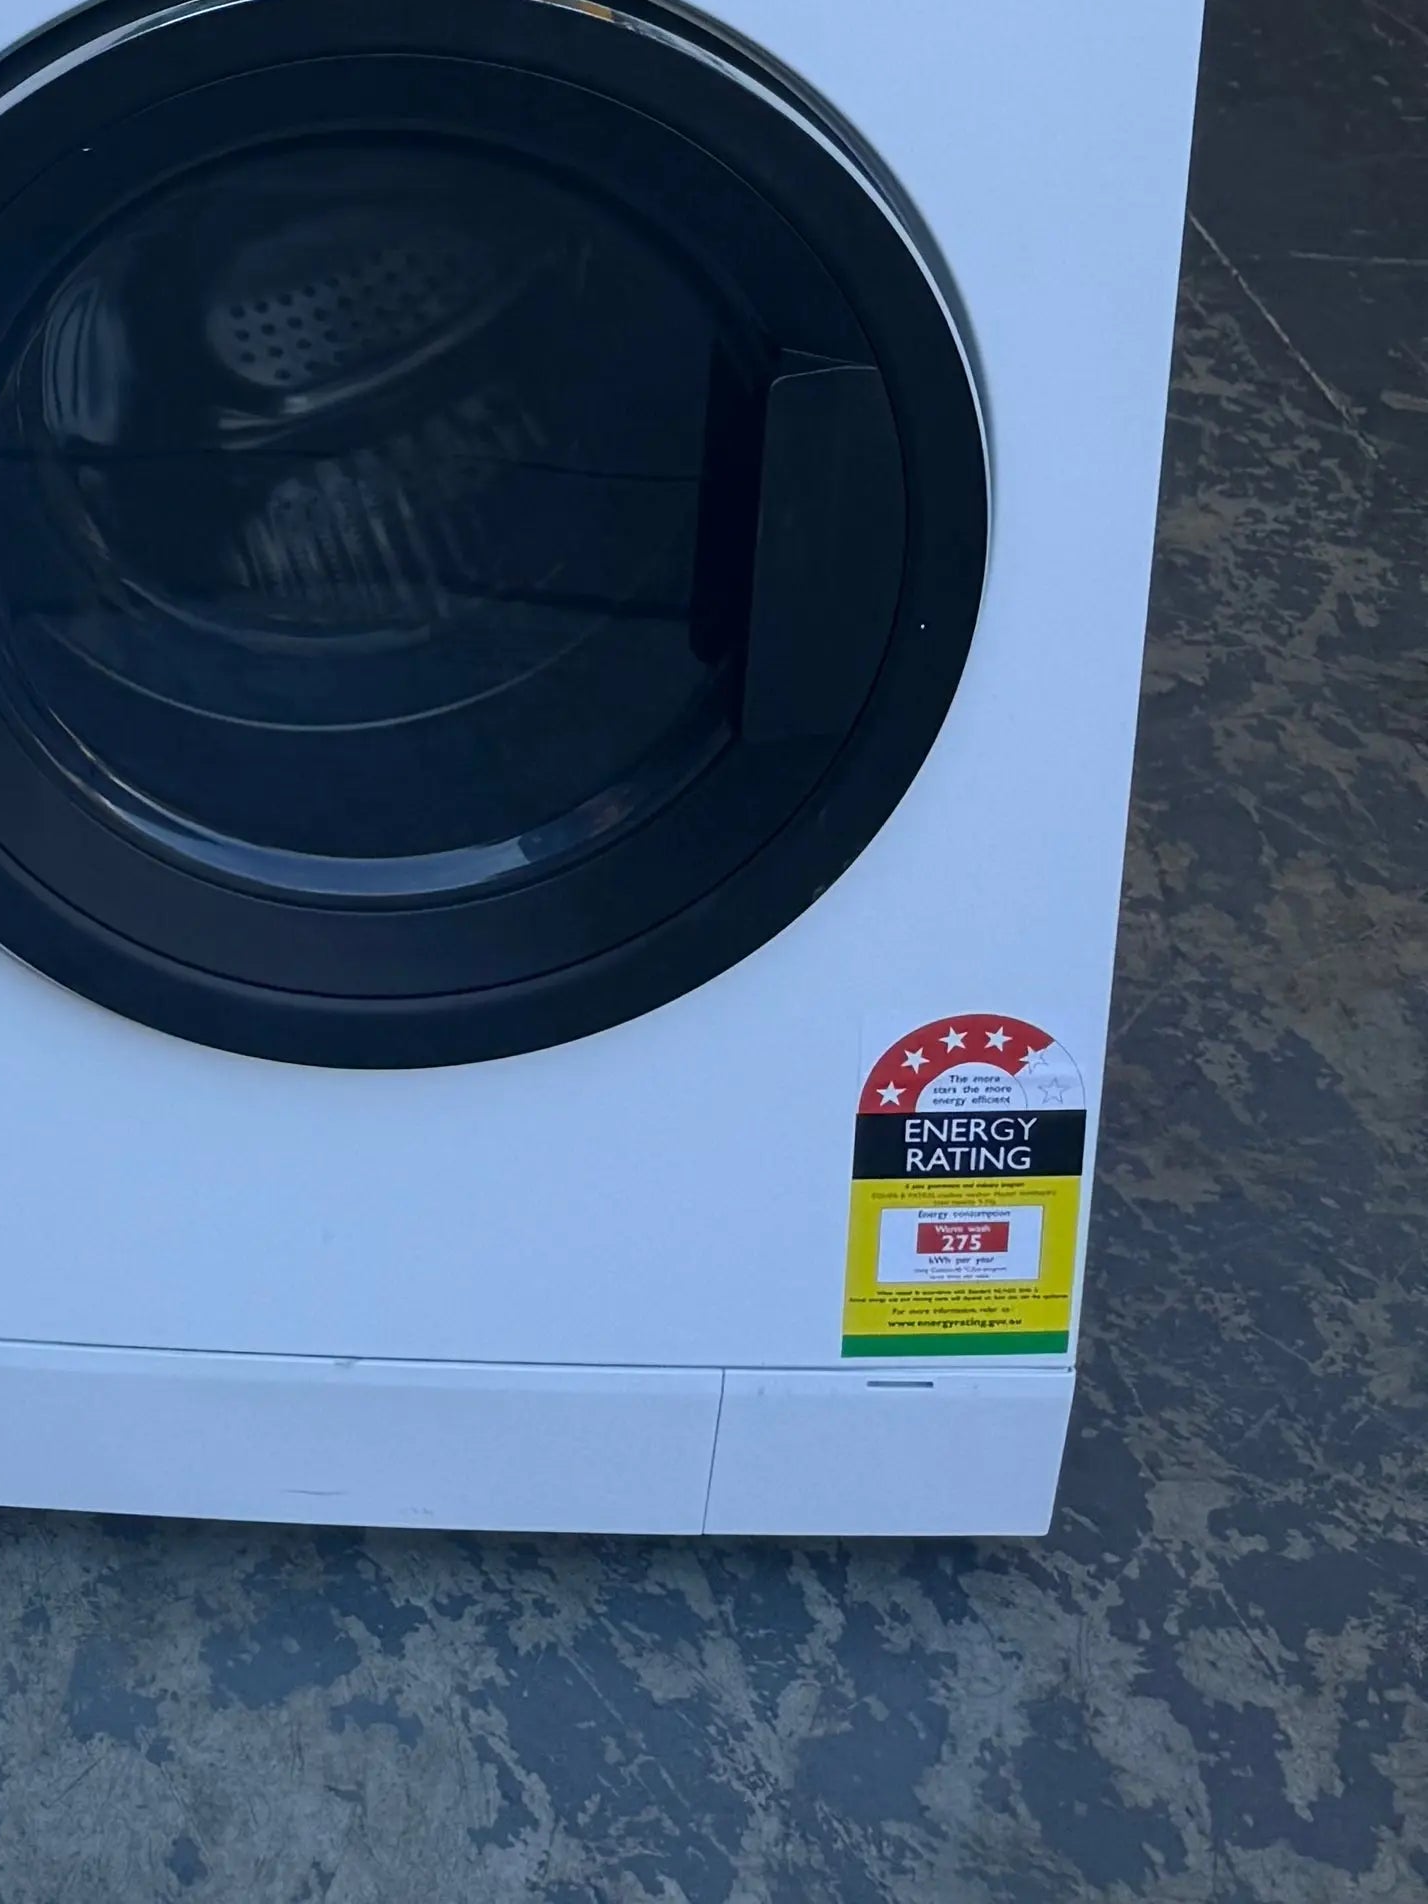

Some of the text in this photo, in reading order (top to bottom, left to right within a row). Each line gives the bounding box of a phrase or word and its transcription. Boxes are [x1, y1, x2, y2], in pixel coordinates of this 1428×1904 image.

[949, 1075, 968, 1083] The
[933, 1098, 966, 1106] energy
[905, 1118, 1037, 1142] ENERGY
[906, 1146, 1031, 1172] RATING
[942, 1234, 981, 1251] 275
